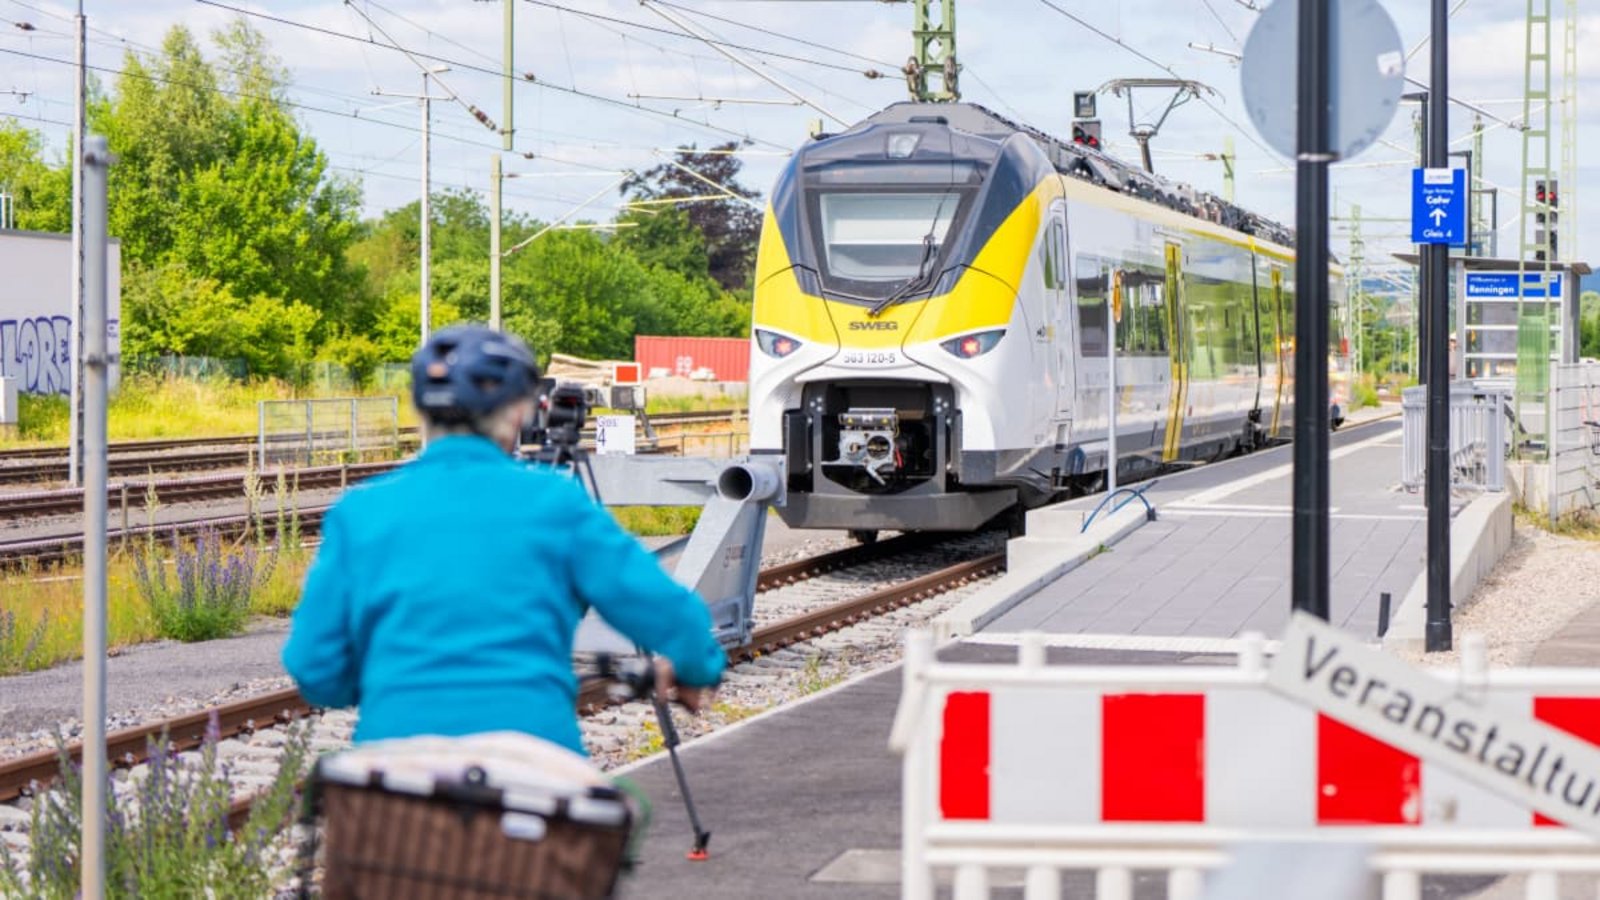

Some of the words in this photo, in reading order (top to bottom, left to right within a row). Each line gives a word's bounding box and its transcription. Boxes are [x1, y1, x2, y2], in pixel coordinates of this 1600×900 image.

[1423, 229, 1444, 238] Gleis
[1446, 229, 1453, 238] 4
[1469, 284, 1515, 296] Renningen
[849, 321, 898, 331] SWEG
[867, 352, 896, 364] 120-5
[597, 427, 607, 447] 4
